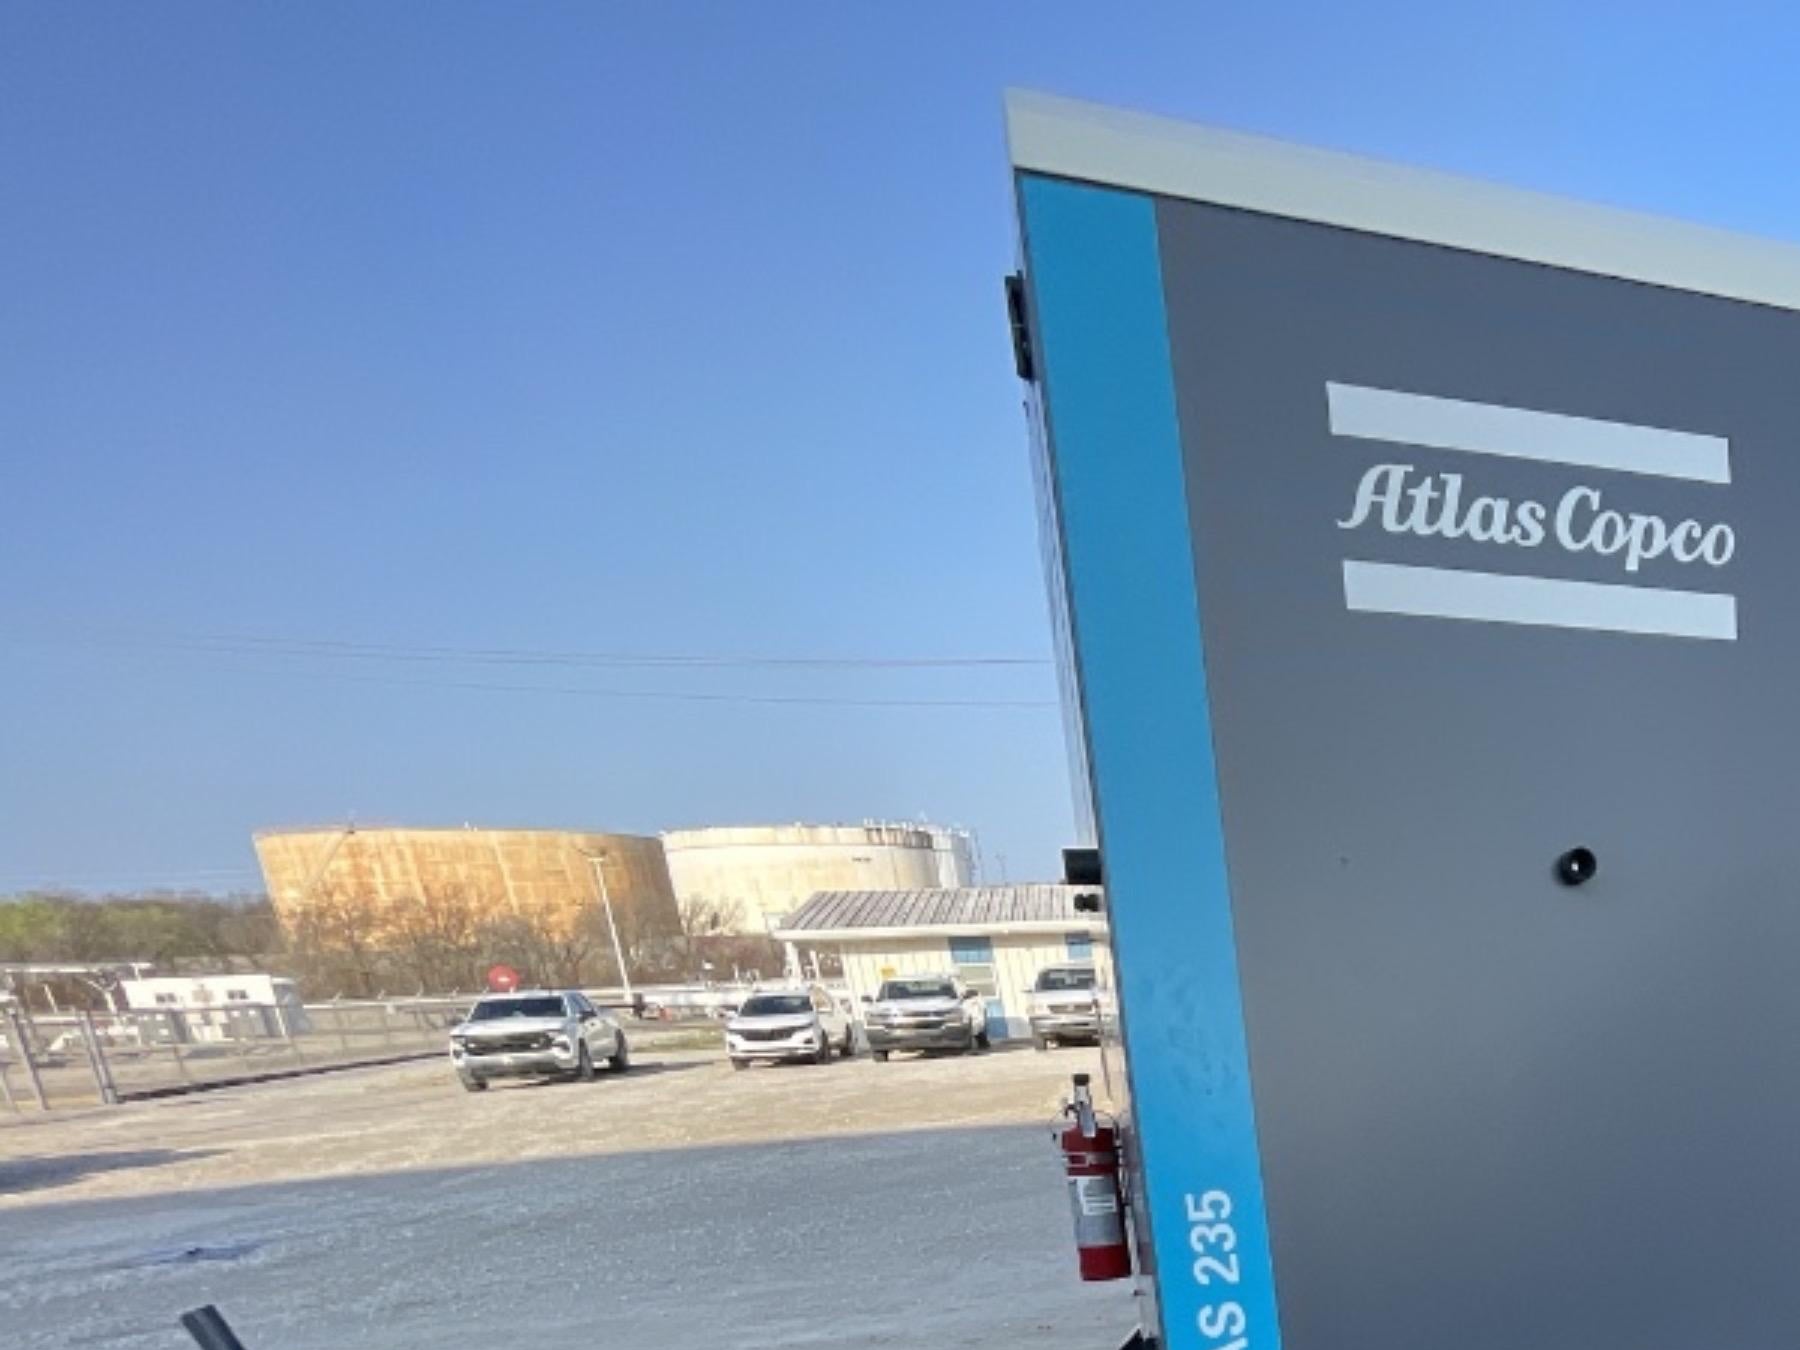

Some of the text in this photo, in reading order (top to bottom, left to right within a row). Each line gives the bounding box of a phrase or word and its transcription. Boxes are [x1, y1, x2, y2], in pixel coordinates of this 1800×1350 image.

[1336, 463, 1735, 571] Atlas Copco
[1184, 1189, 1240, 1286] 235
